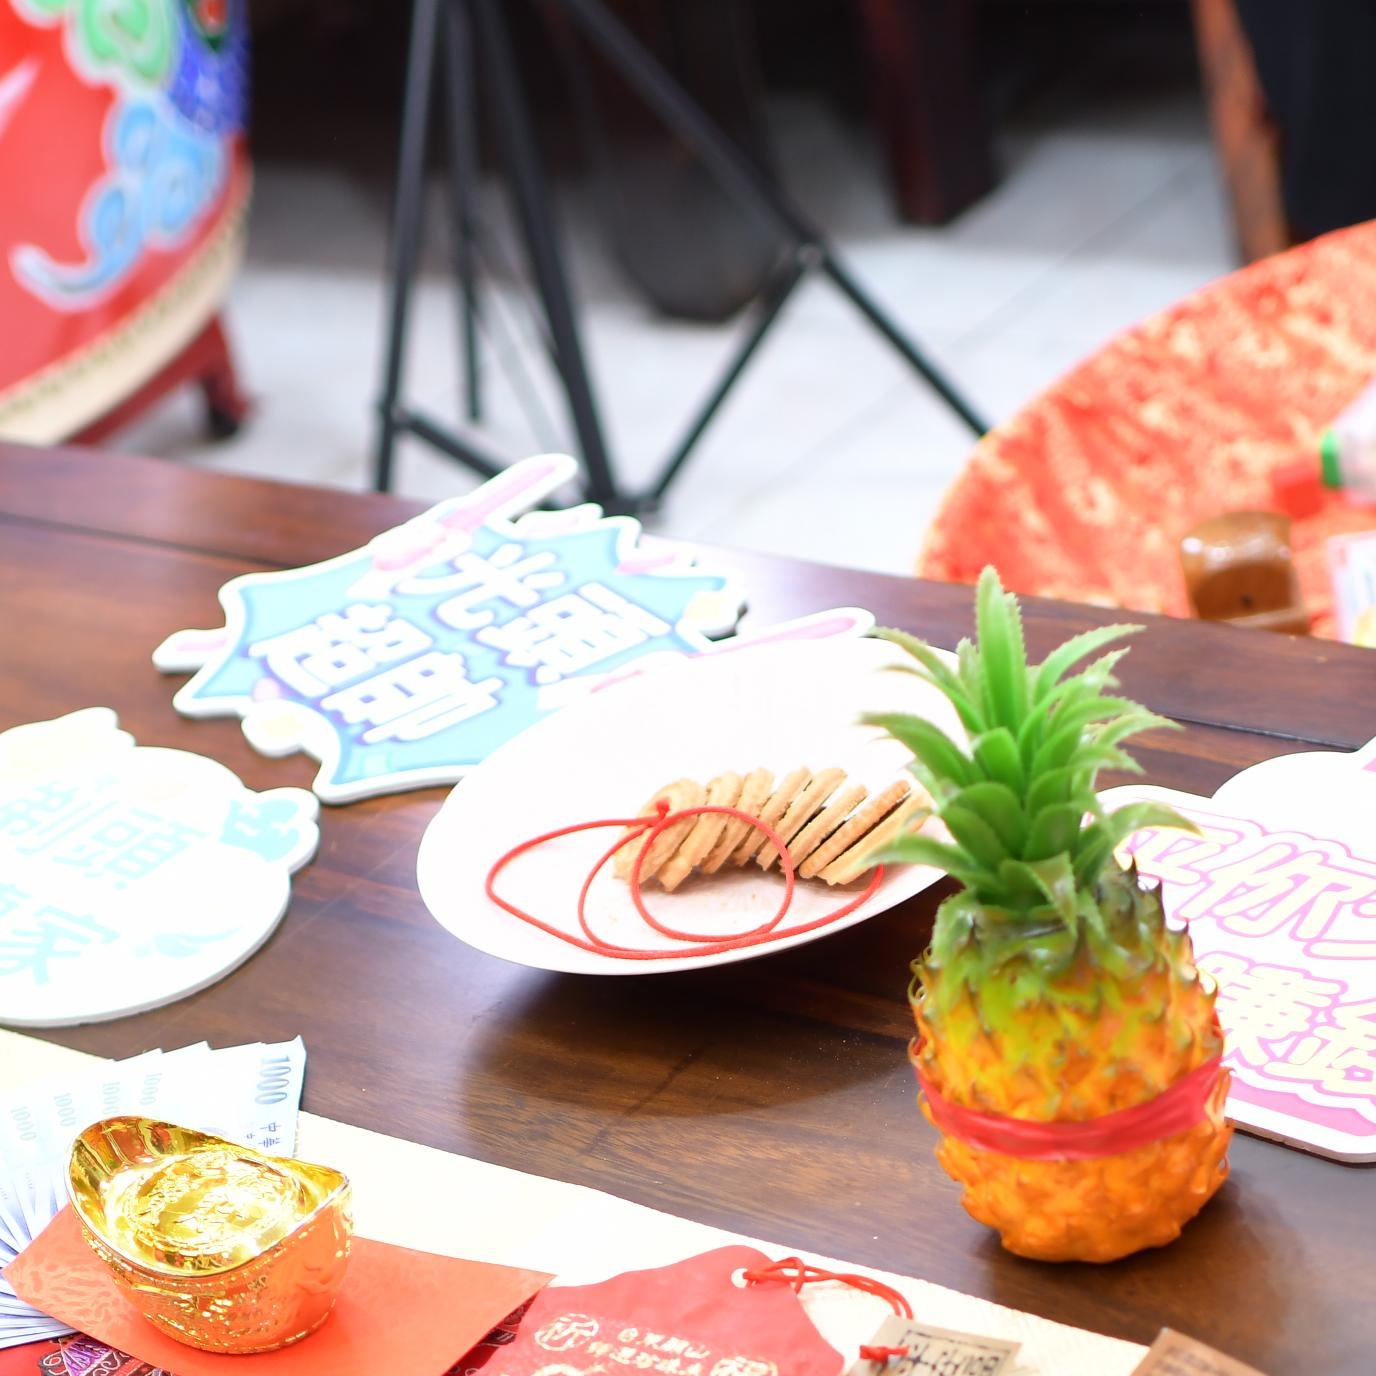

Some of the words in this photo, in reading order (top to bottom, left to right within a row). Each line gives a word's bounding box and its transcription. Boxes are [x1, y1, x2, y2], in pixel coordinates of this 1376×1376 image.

[248, 603, 506, 745] 超帥
[396, 543, 676, 684] 光頭
[255, 1056, 292, 1104] 1000
